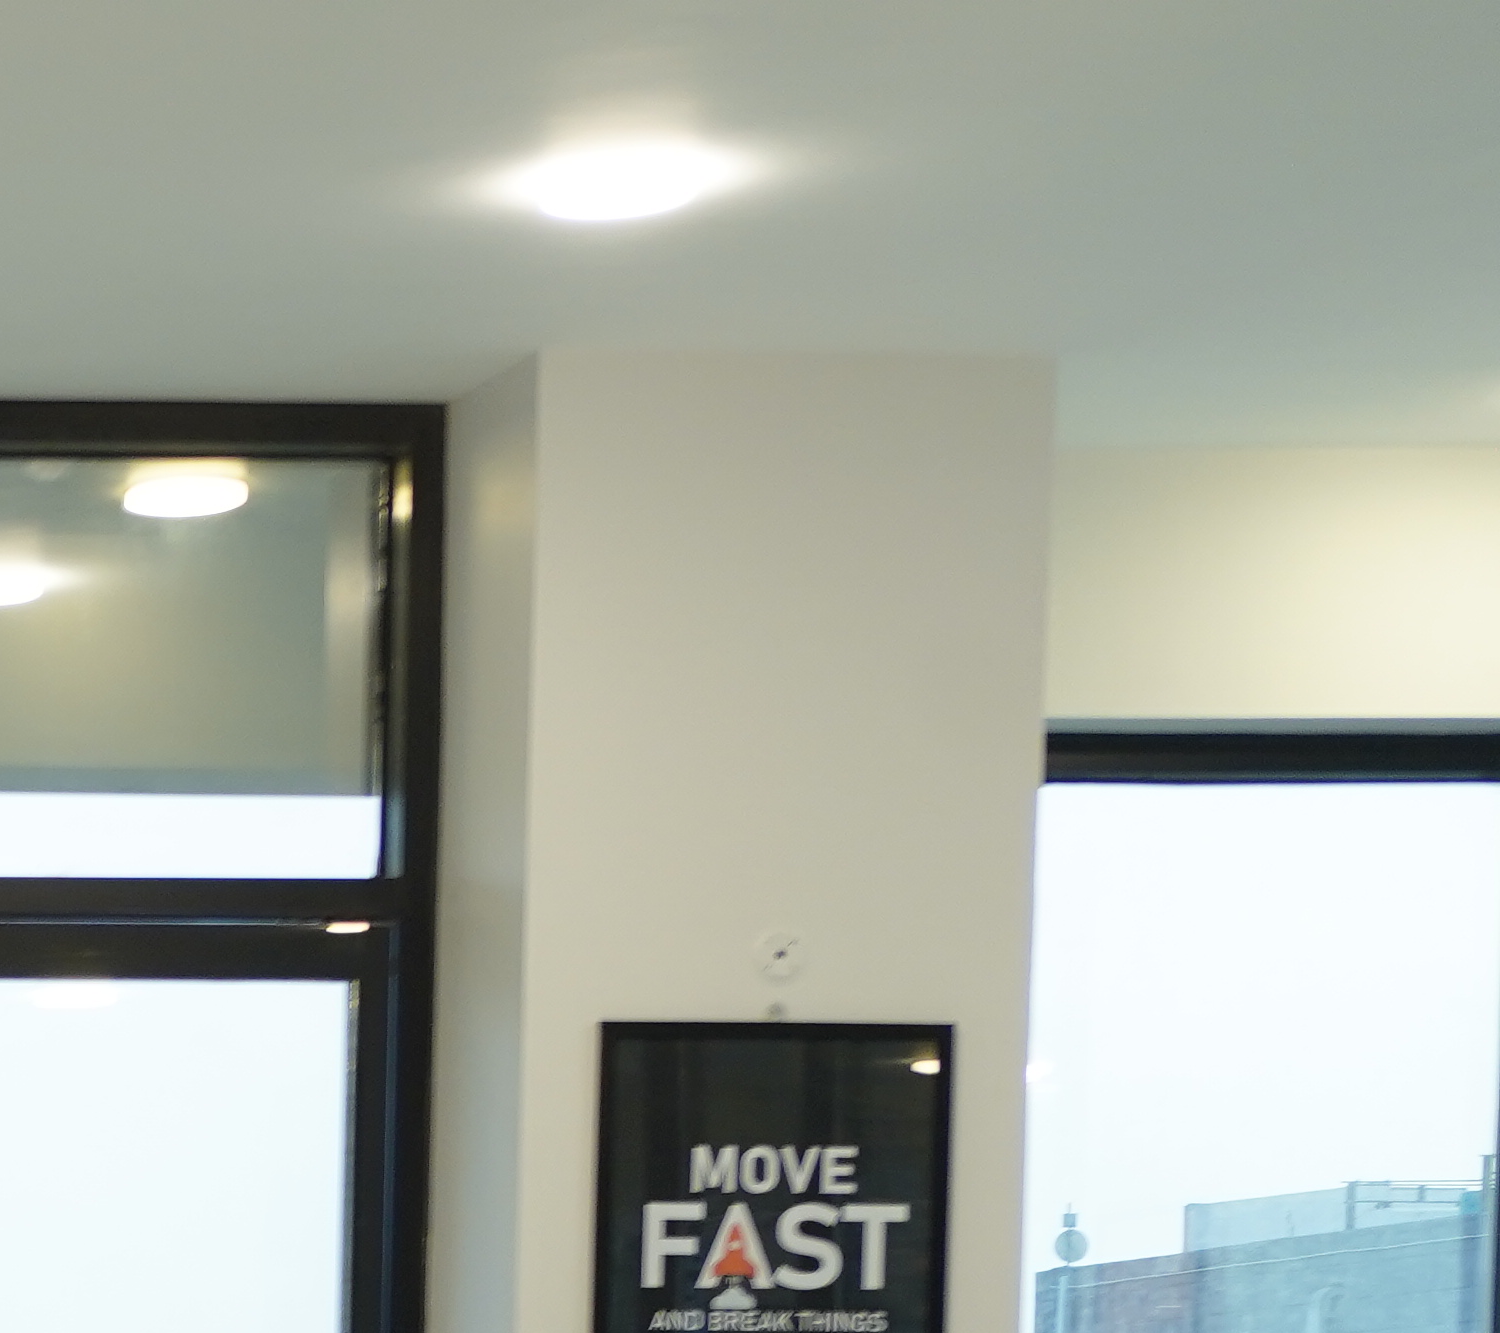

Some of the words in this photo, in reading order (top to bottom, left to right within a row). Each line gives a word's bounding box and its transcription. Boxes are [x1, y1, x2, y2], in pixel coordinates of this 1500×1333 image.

[689, 1144, 860, 1194] MOVE
[640, 1201, 911, 1291] FAST
[648, 1309, 705, 1331] AND
[707, 1310, 794, 1332] BREAK
[795, 1310, 889, 1333] THINGS
